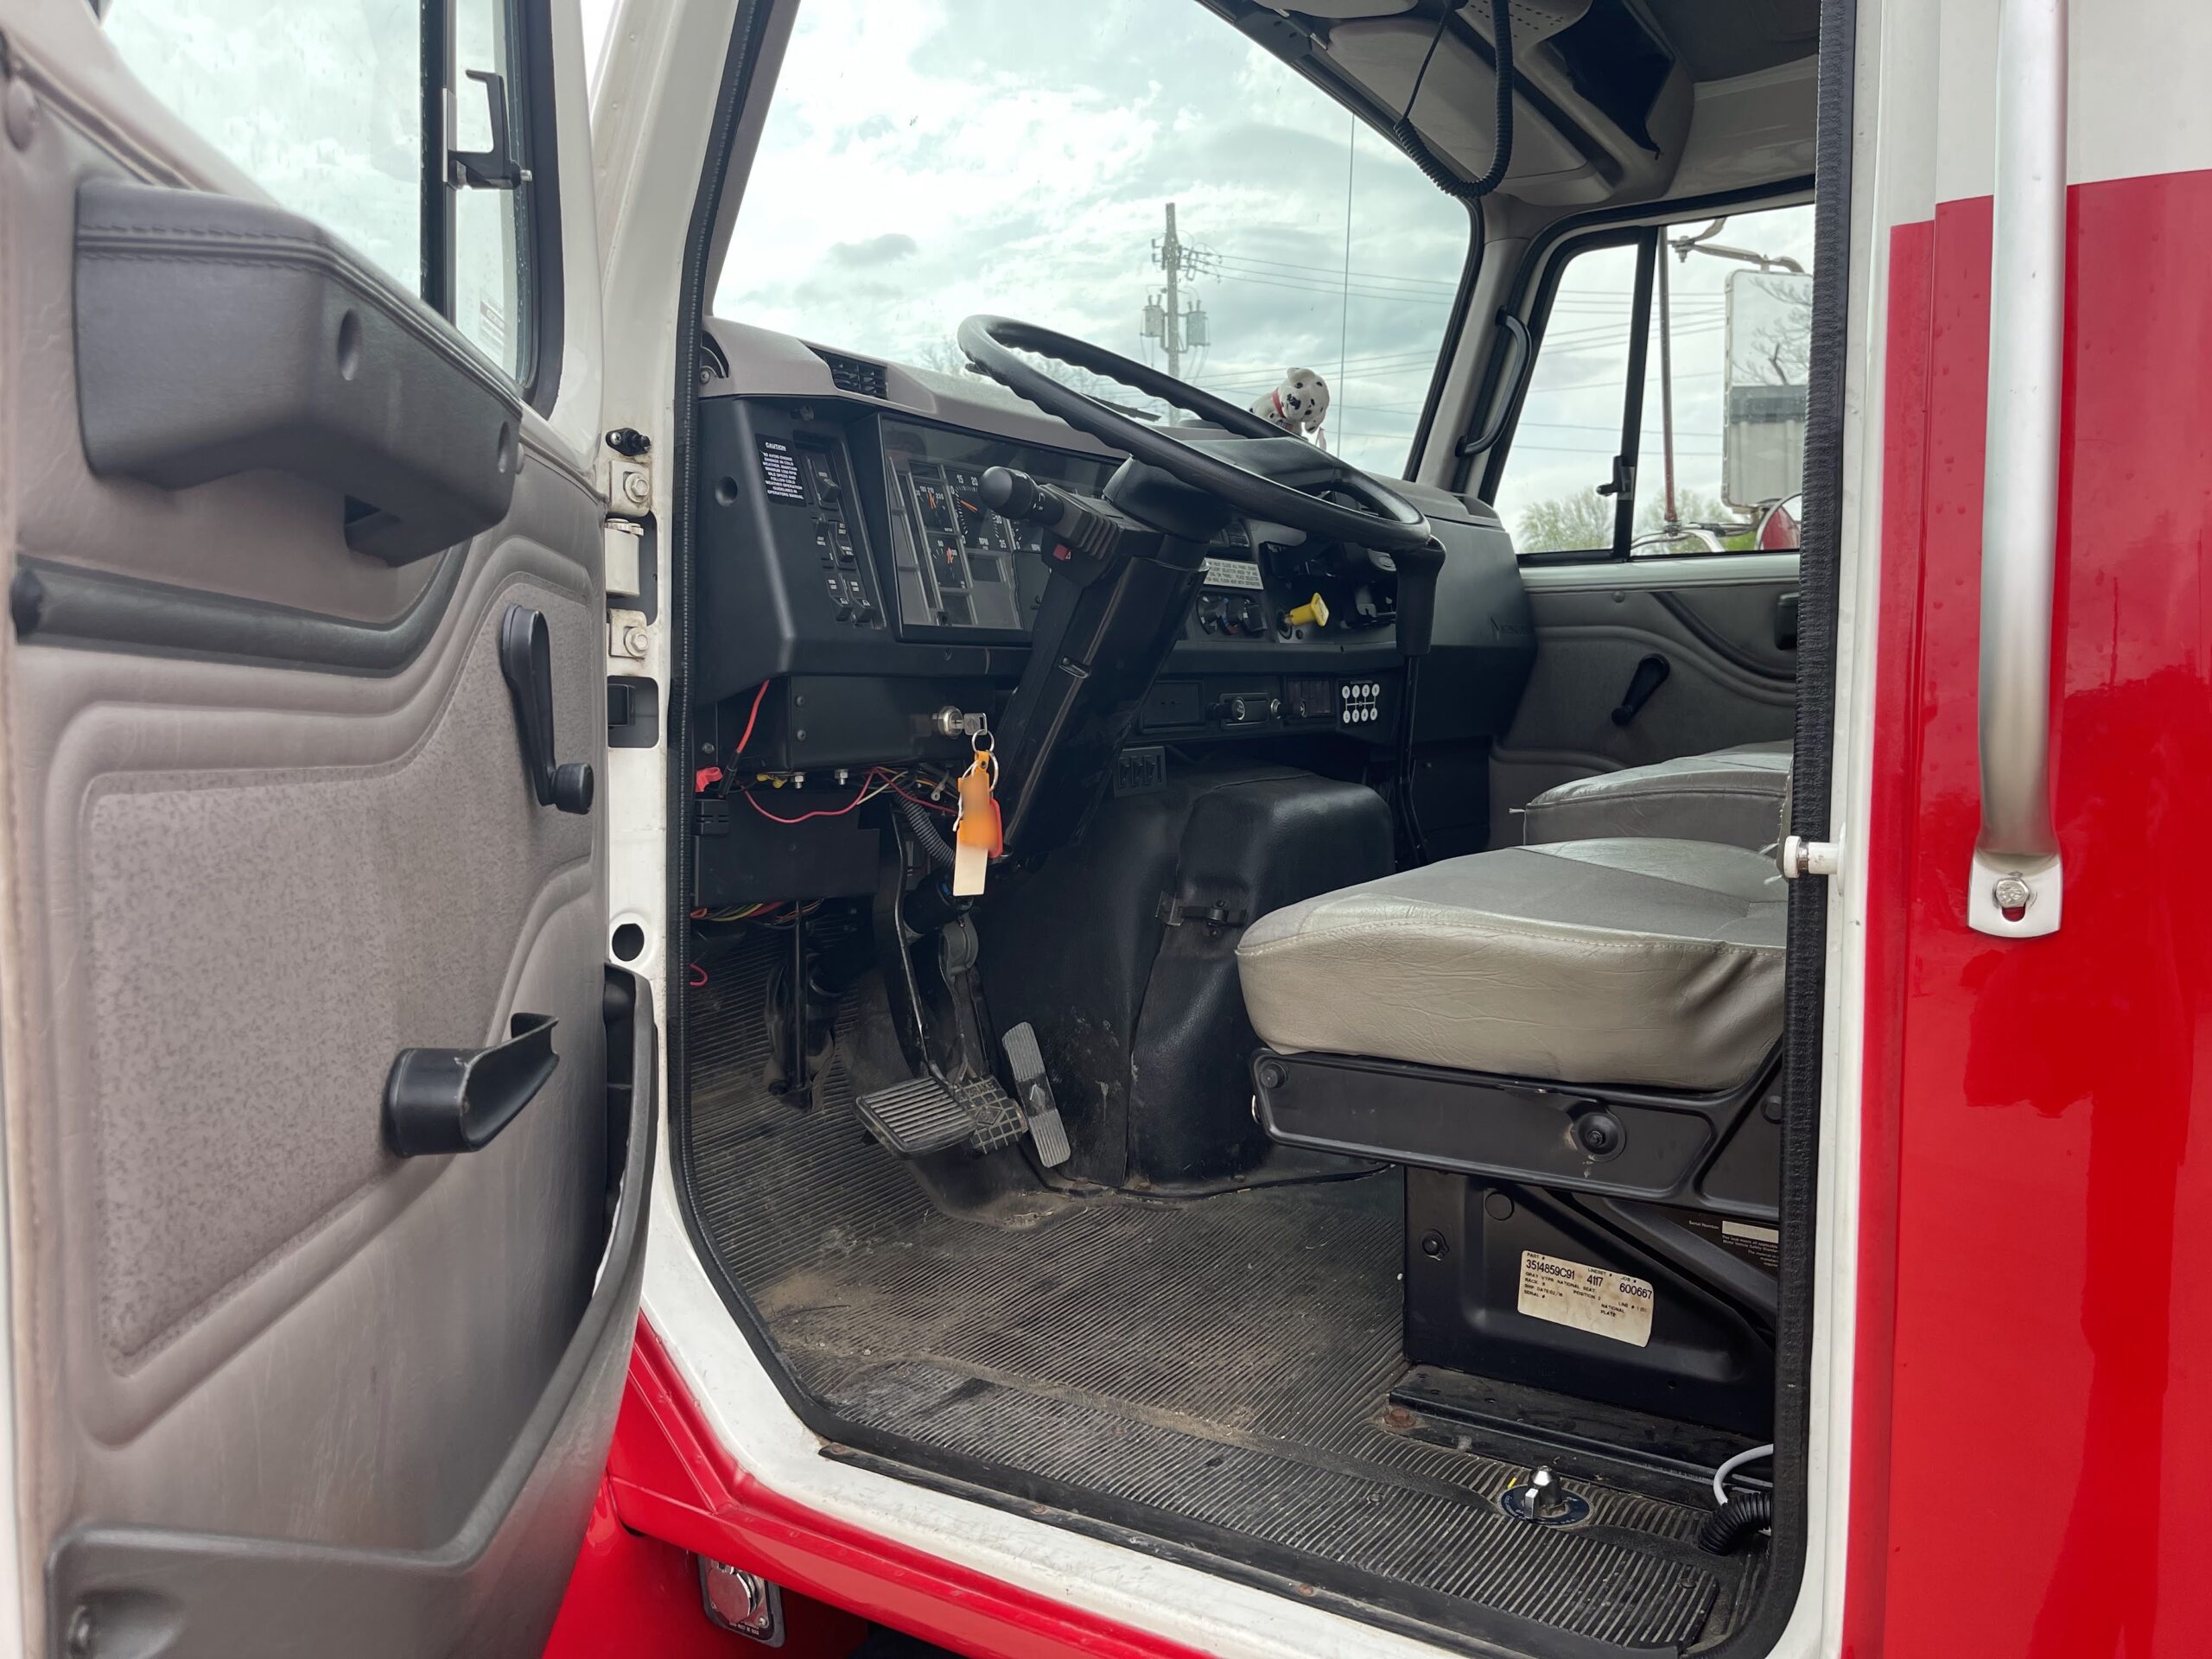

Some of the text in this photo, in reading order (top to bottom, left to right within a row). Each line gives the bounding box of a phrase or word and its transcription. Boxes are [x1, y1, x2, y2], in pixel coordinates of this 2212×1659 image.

[765, 442, 786, 451] CAUTION
[957, 474, 979, 486] 15 20
[999, 539, 1007, 549] 35
[1526, 1259, 1575, 1280] 3514859C91
[1557, 1280, 1580, 1288] NATIONAL
[1586, 1274, 1604, 1287] 4117
[1573, 1289, 1596, 1299] POSITION
[1619, 1282, 1652, 1299] 600667
[1601, 1303, 1624, 1313] NATIONAL
